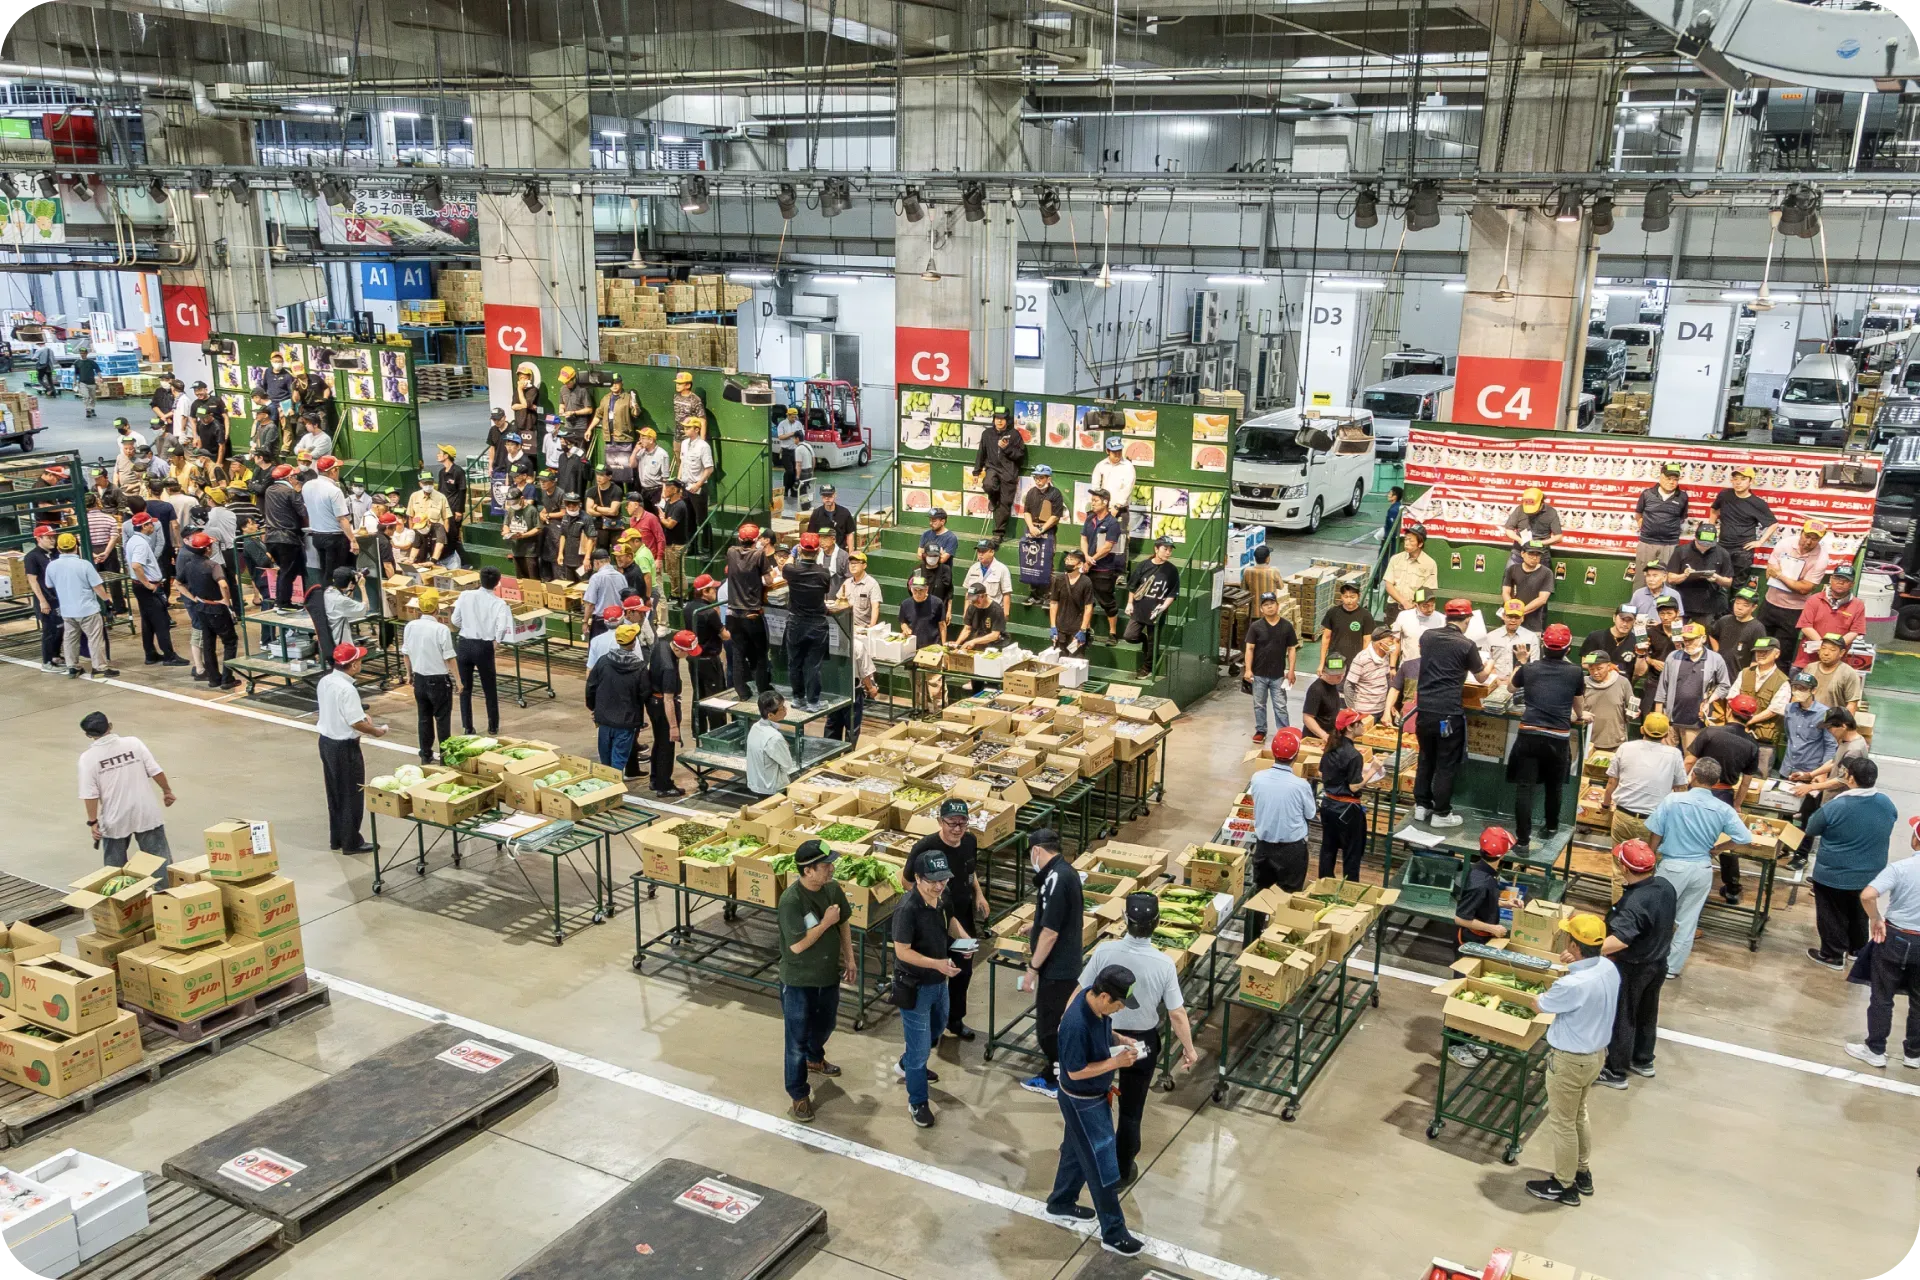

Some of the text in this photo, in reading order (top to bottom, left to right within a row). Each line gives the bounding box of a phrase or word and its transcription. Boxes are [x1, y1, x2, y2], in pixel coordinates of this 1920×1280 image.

[369, 266, 388, 286] A1
[403, 267, 423, 286] A1
[1015, 294, 1037, 313] D2
[176, 302, 200, 327] C1
[1313, 306, 1343, 325] D3
[1677, 321, 1714, 342] D4
[1779, 320, 1791, 330] -2
[497, 325, 528, 353] C2
[1330, 346, 1342, 357] -1
[911, 351, 950, 382] C3
[1697, 364, 1711, 377] -1
[1476, 384, 1533, 421] C4
[99, 750, 135, 769] FITH
[210, 851, 232, 863] すいか
[186, 911, 220, 931] すいか
[263, 903, 295, 925] すいか
[268, 949, 300, 971] すいか
[232, 965, 264, 988] すいか
[1245, 980, 1271, 992] スイート
[187, 981, 221, 1005] すいか
